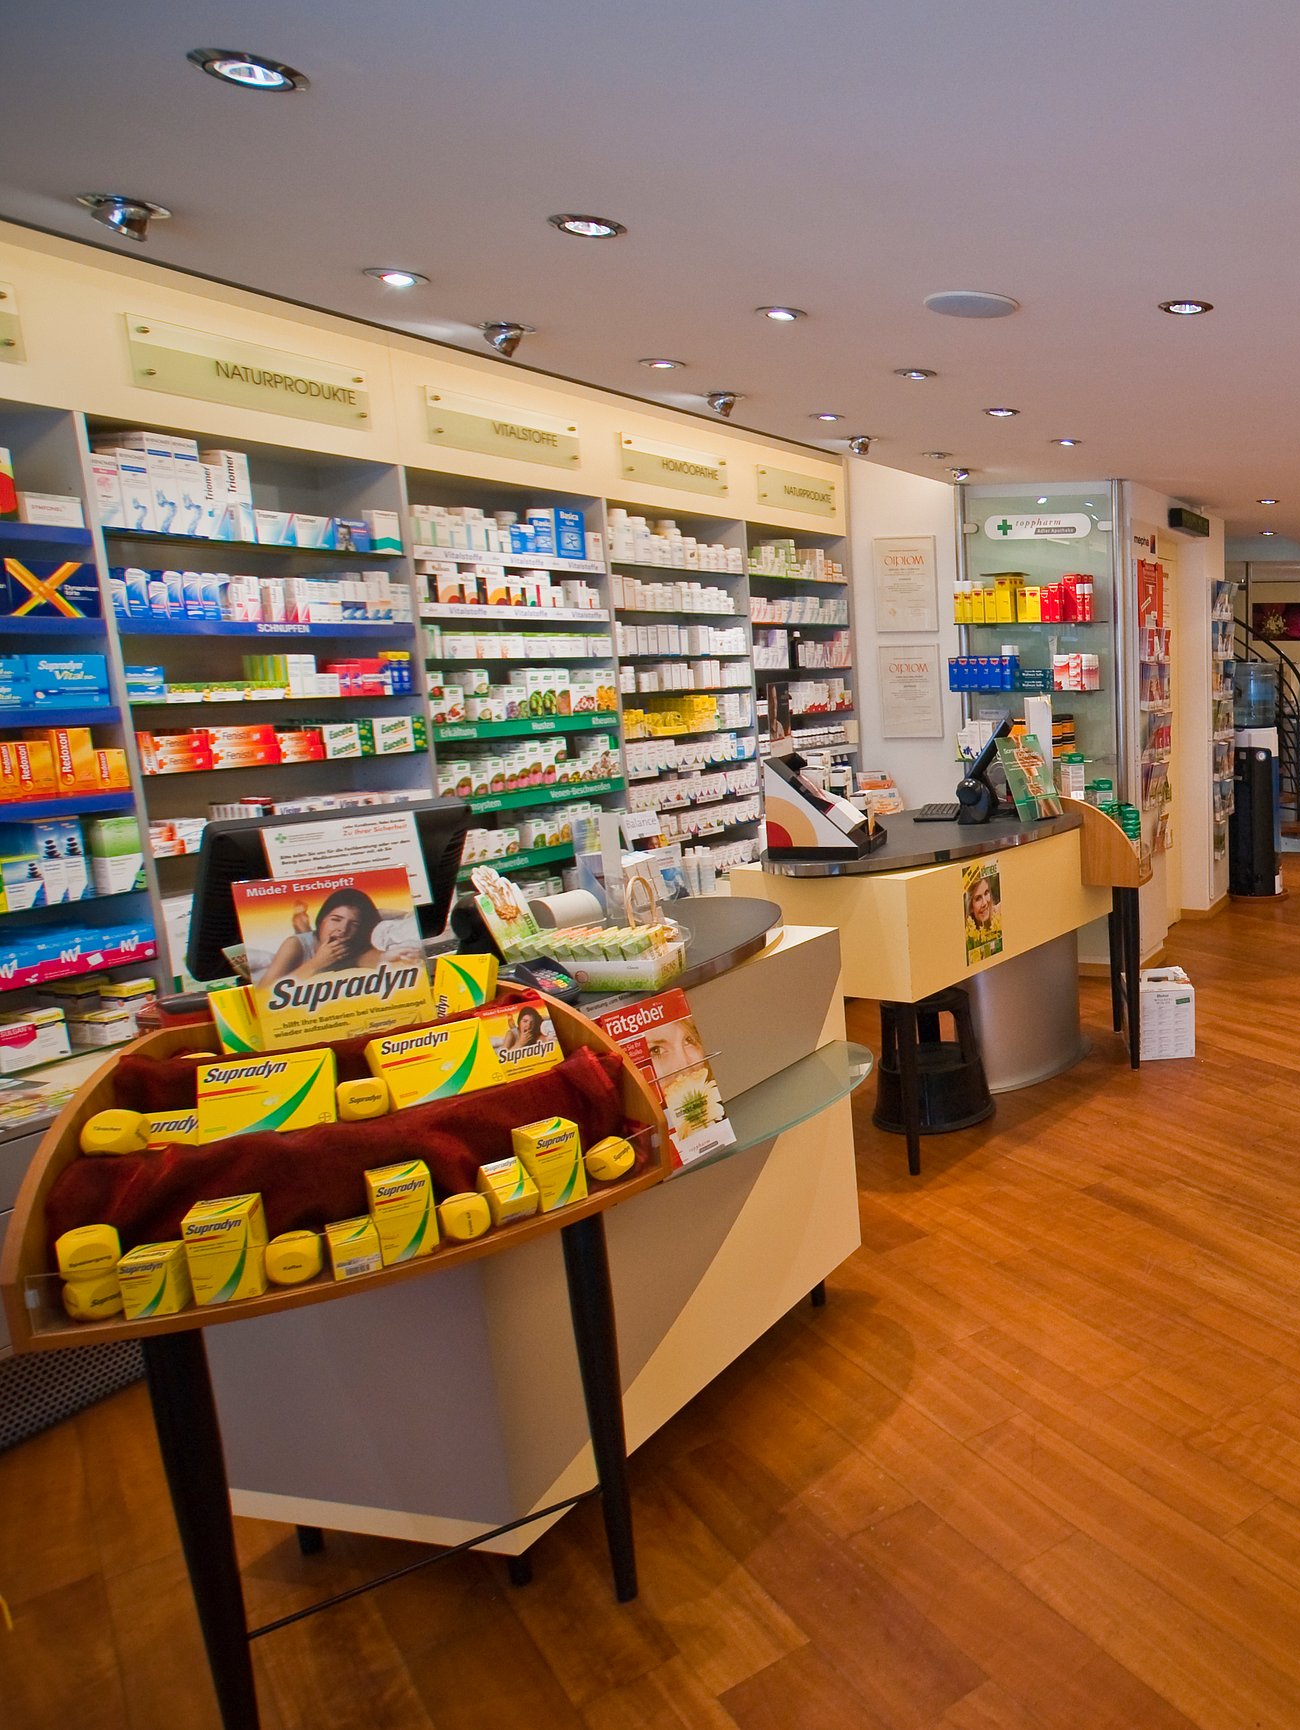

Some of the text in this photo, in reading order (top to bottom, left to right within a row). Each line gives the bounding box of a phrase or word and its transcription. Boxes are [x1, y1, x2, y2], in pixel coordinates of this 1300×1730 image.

[215, 360, 357, 406] NATURPRODUKTE
[492, 421, 558, 448] VITALSTOFFE
[226, 455, 238, 495] Triomer
[661, 458, 719, 481] HOMÖOPATHIE
[783, 484, 832, 505] NATURPRODUKTE
[1015, 517, 1062, 528] toppharm
[1133, 535, 1150, 547] mepha
[443, 551, 483, 562] Vitalstoffe
[510, 556, 544, 567] Vitalstoffe
[568, 561, 599, 571] Vitalstoffe
[449, 607, 487, 616] Vitalstoffe
[514, 609, 548, 618] Vitalstoffe
[257, 624, 311, 634] SCHNUPFEN
[37, 660, 83, 671] Supradyn
[54, 671, 83, 681] Vital
[18, 744, 31, 780] Redoxon
[60, 732, 73, 774] Redoxon
[101, 752, 109, 779] Redoxon
[374, 823, 408, 833] Sicherheit
[626, 817, 657, 829] Balance
[246, 877, 355, 898] Müde? Erschöpft?
[268, 965, 419, 1012] Supradyn
[301, 1000, 427, 1026] Ihre Batterien bei Vitaminmangel
[606, 1004, 665, 1037] ratgeber
[274, 1021, 351, 1038] wieder aufzuladen.
[381, 1030, 449, 1056] Supradyn
[498, 1040, 554, 1064] Supradyn
[203, 1060, 288, 1084] Supradyn
[348, 1093, 382, 1106] Supradyn
[535, 1130, 576, 1150] Supradyn
[375, 1179, 426, 1199] Supradyn
[185, 1218, 242, 1237] Supradyn
[119, 1262, 164, 1276] Supradyn
